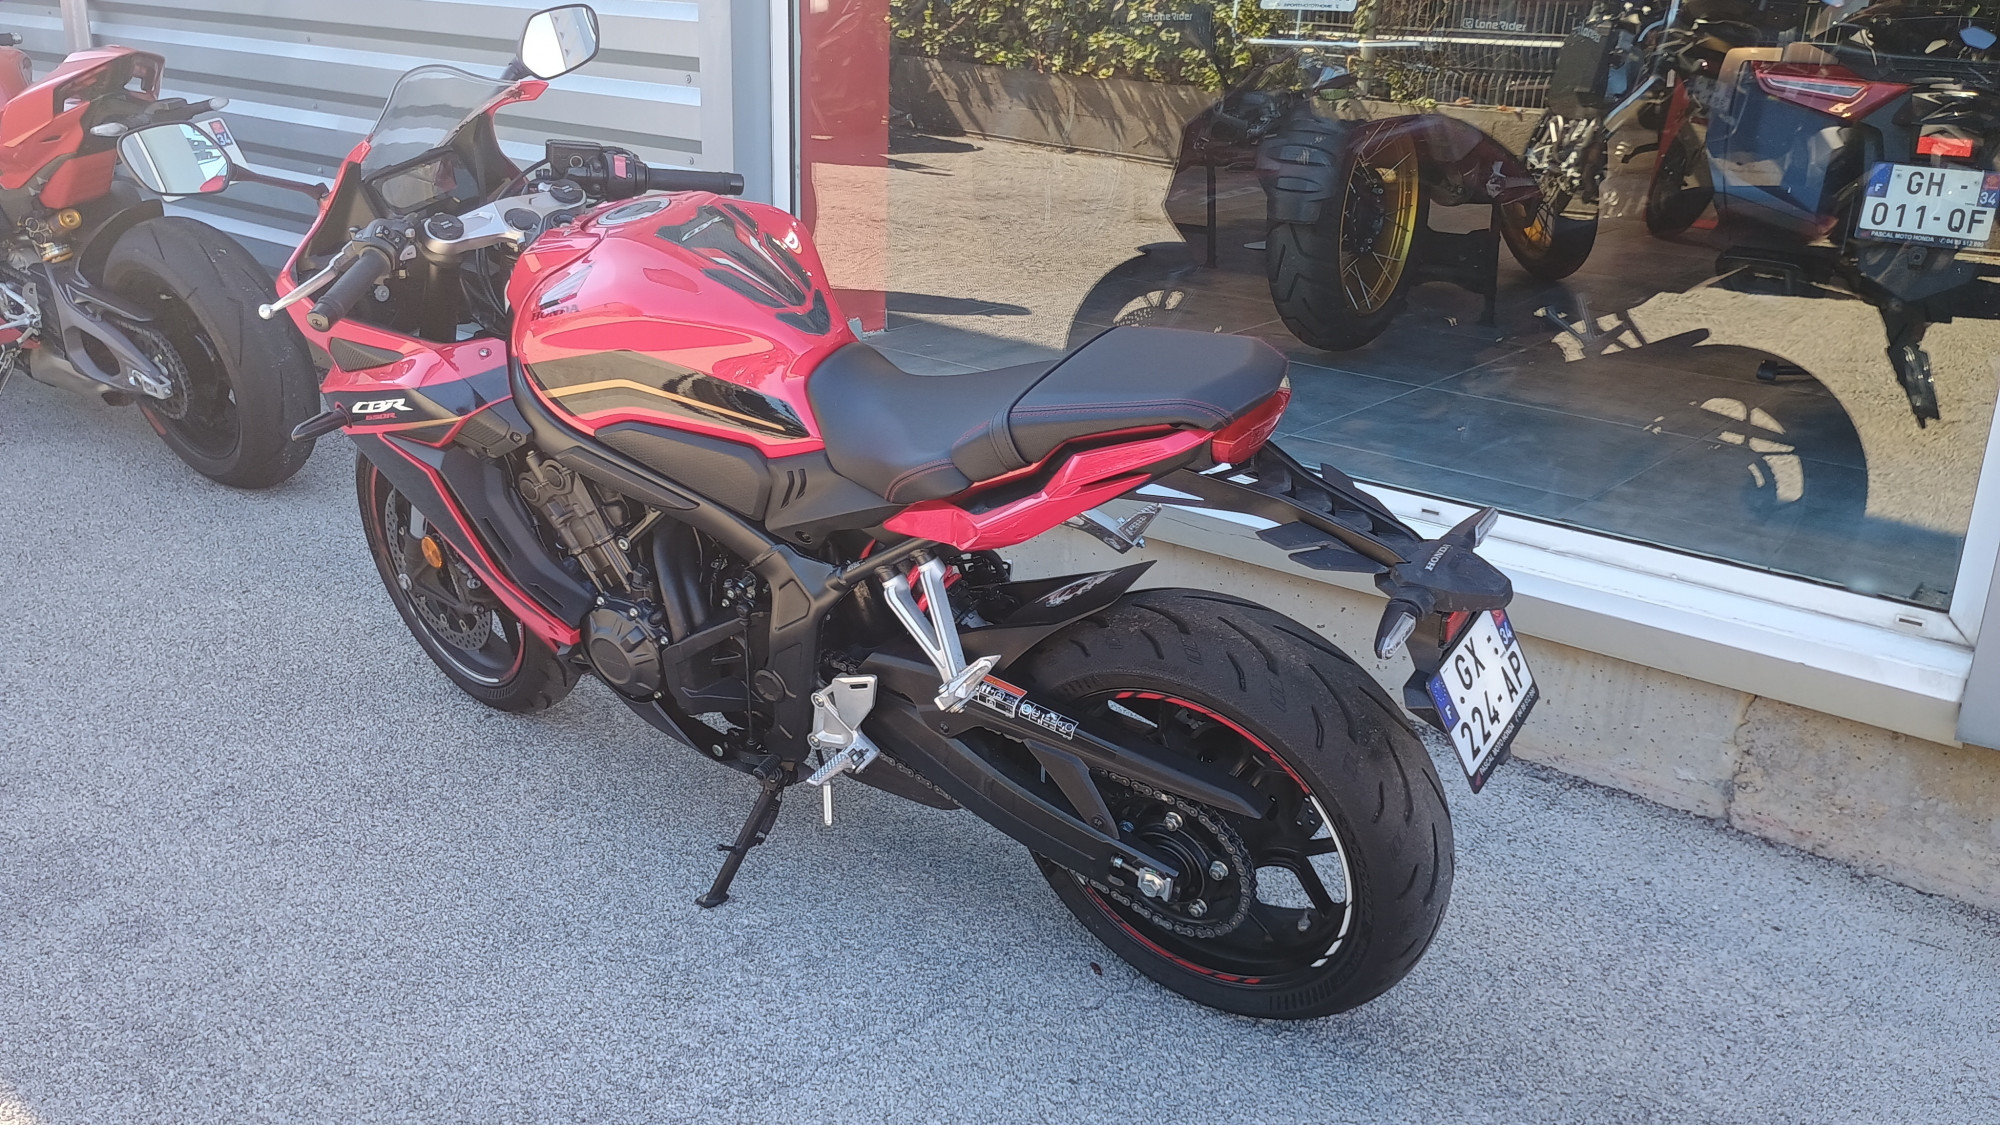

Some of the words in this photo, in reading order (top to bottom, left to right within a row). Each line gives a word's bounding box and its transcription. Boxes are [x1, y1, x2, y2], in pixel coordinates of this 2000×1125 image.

[216, 132, 231, 146] 34
[1874, 183, 1883, 192] F
[1906, 171, 1946, 197] GH
[1979, 191, 1997, 205] 34
[1870, 230, 1894, 239] PASCAL
[531, 304, 579, 320] HONDA
[352, 398, 414, 413] CBR
[1424, 543, 1451, 571] HONDA
[1499, 620, 1513, 645] 34
[1454, 636, 1486, 691] GX
[1444, 705, 1453, 720] F
[1479, 753, 1495, 775] PASCAL
[1502, 722, 1515, 743] HONDA
